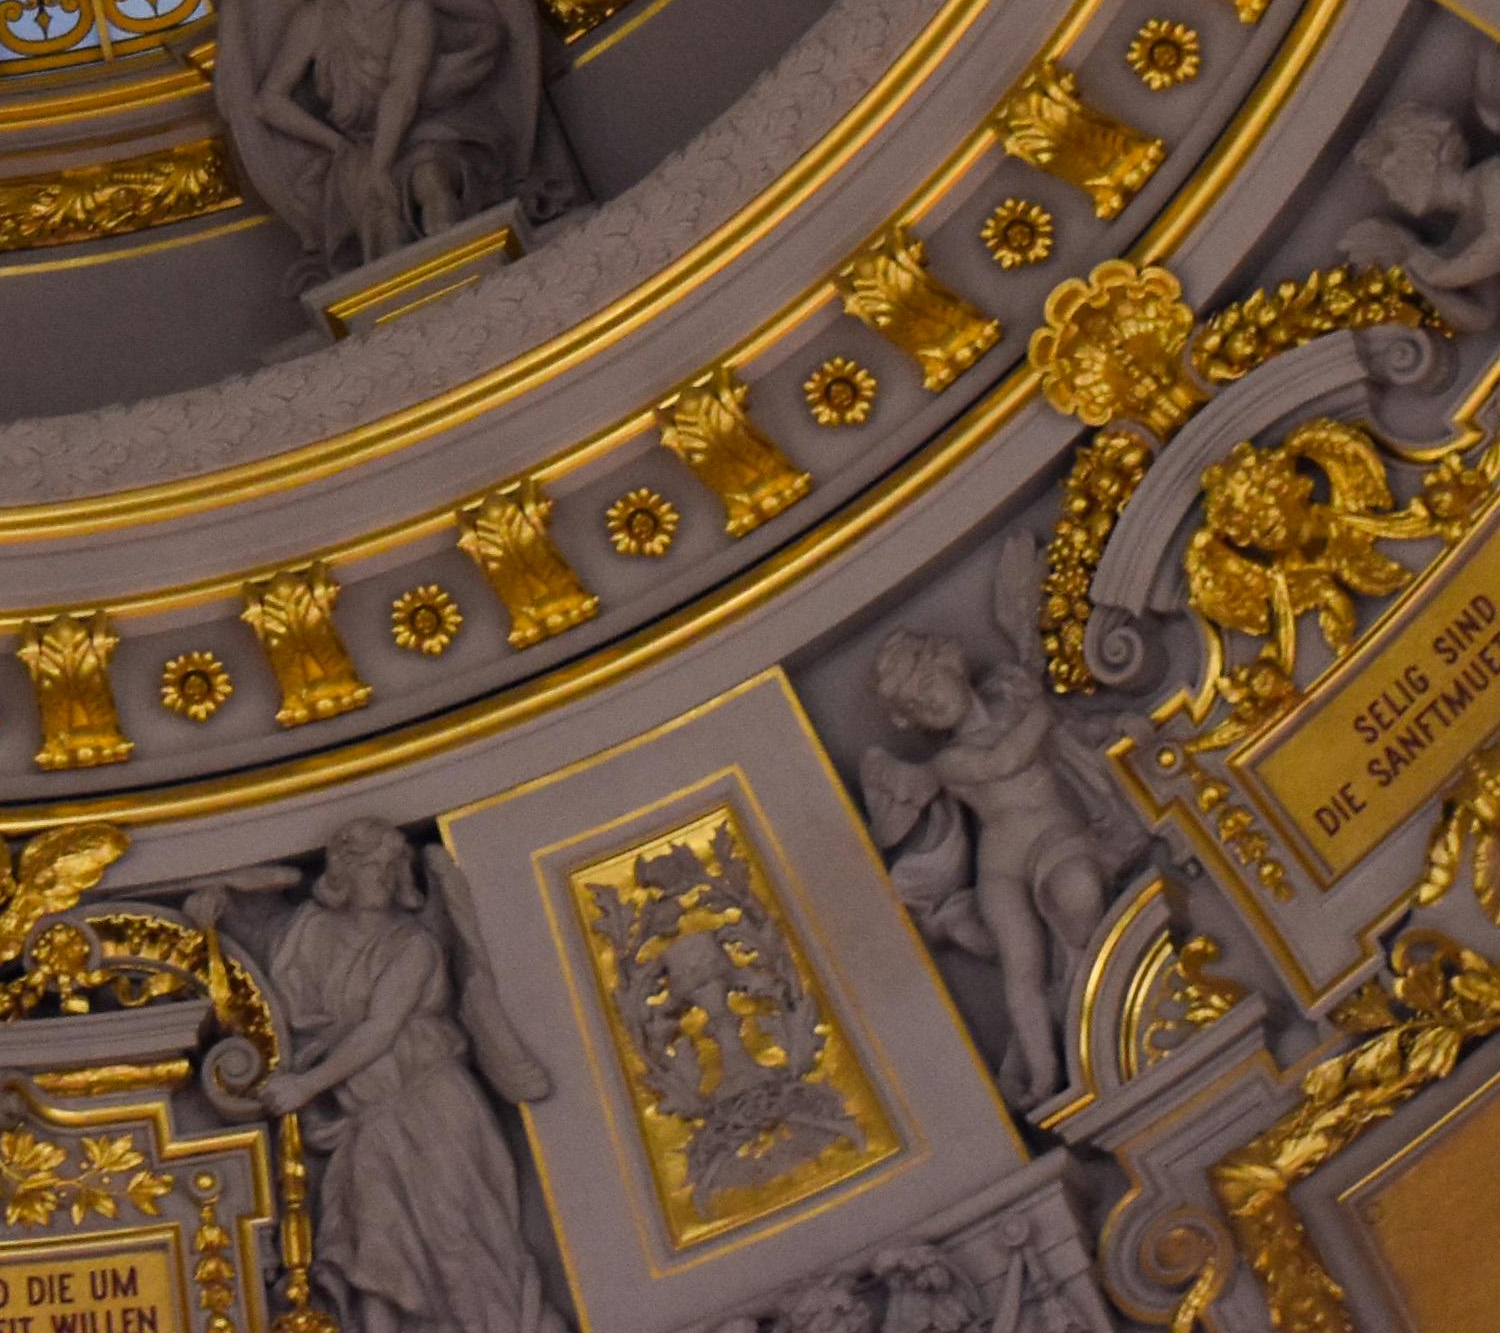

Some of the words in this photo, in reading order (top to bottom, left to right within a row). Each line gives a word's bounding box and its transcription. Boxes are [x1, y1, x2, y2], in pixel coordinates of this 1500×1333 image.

[1354, 664, 1429, 745] SELIG
[1432, 594, 1497, 666] SIND
[1313, 783, 1367, 837] DIE
[27, 1273, 74, 1306] DIE
[90, 1266, 139, 1302] UM
